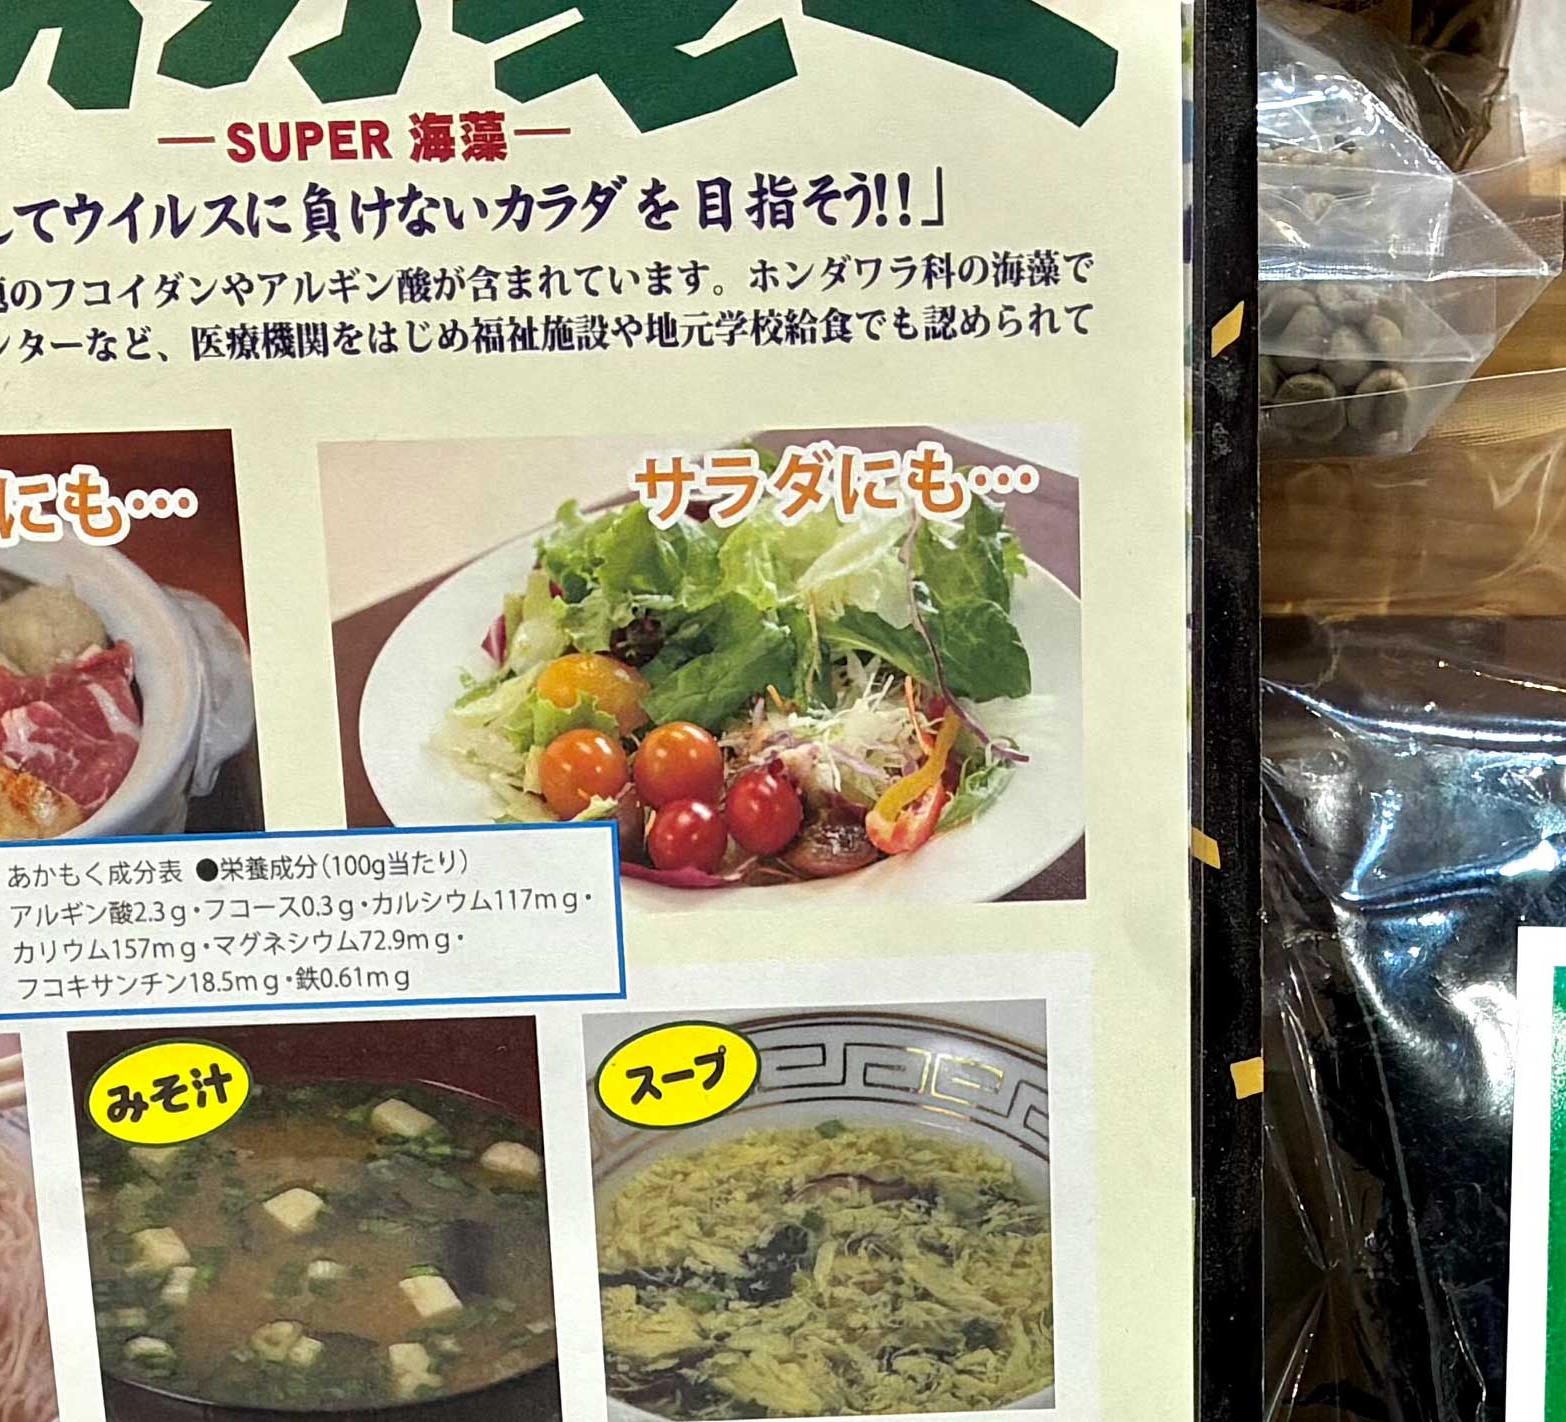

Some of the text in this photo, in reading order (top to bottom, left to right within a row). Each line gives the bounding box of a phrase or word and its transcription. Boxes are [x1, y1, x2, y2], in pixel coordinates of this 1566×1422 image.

[227, 110, 507, 164] SUPER 海藻
[7, 860, 184, 890] あかもく成分表
[106, 1066, 233, 1122] みそ汁
[626, 1046, 730, 1100] スープ
